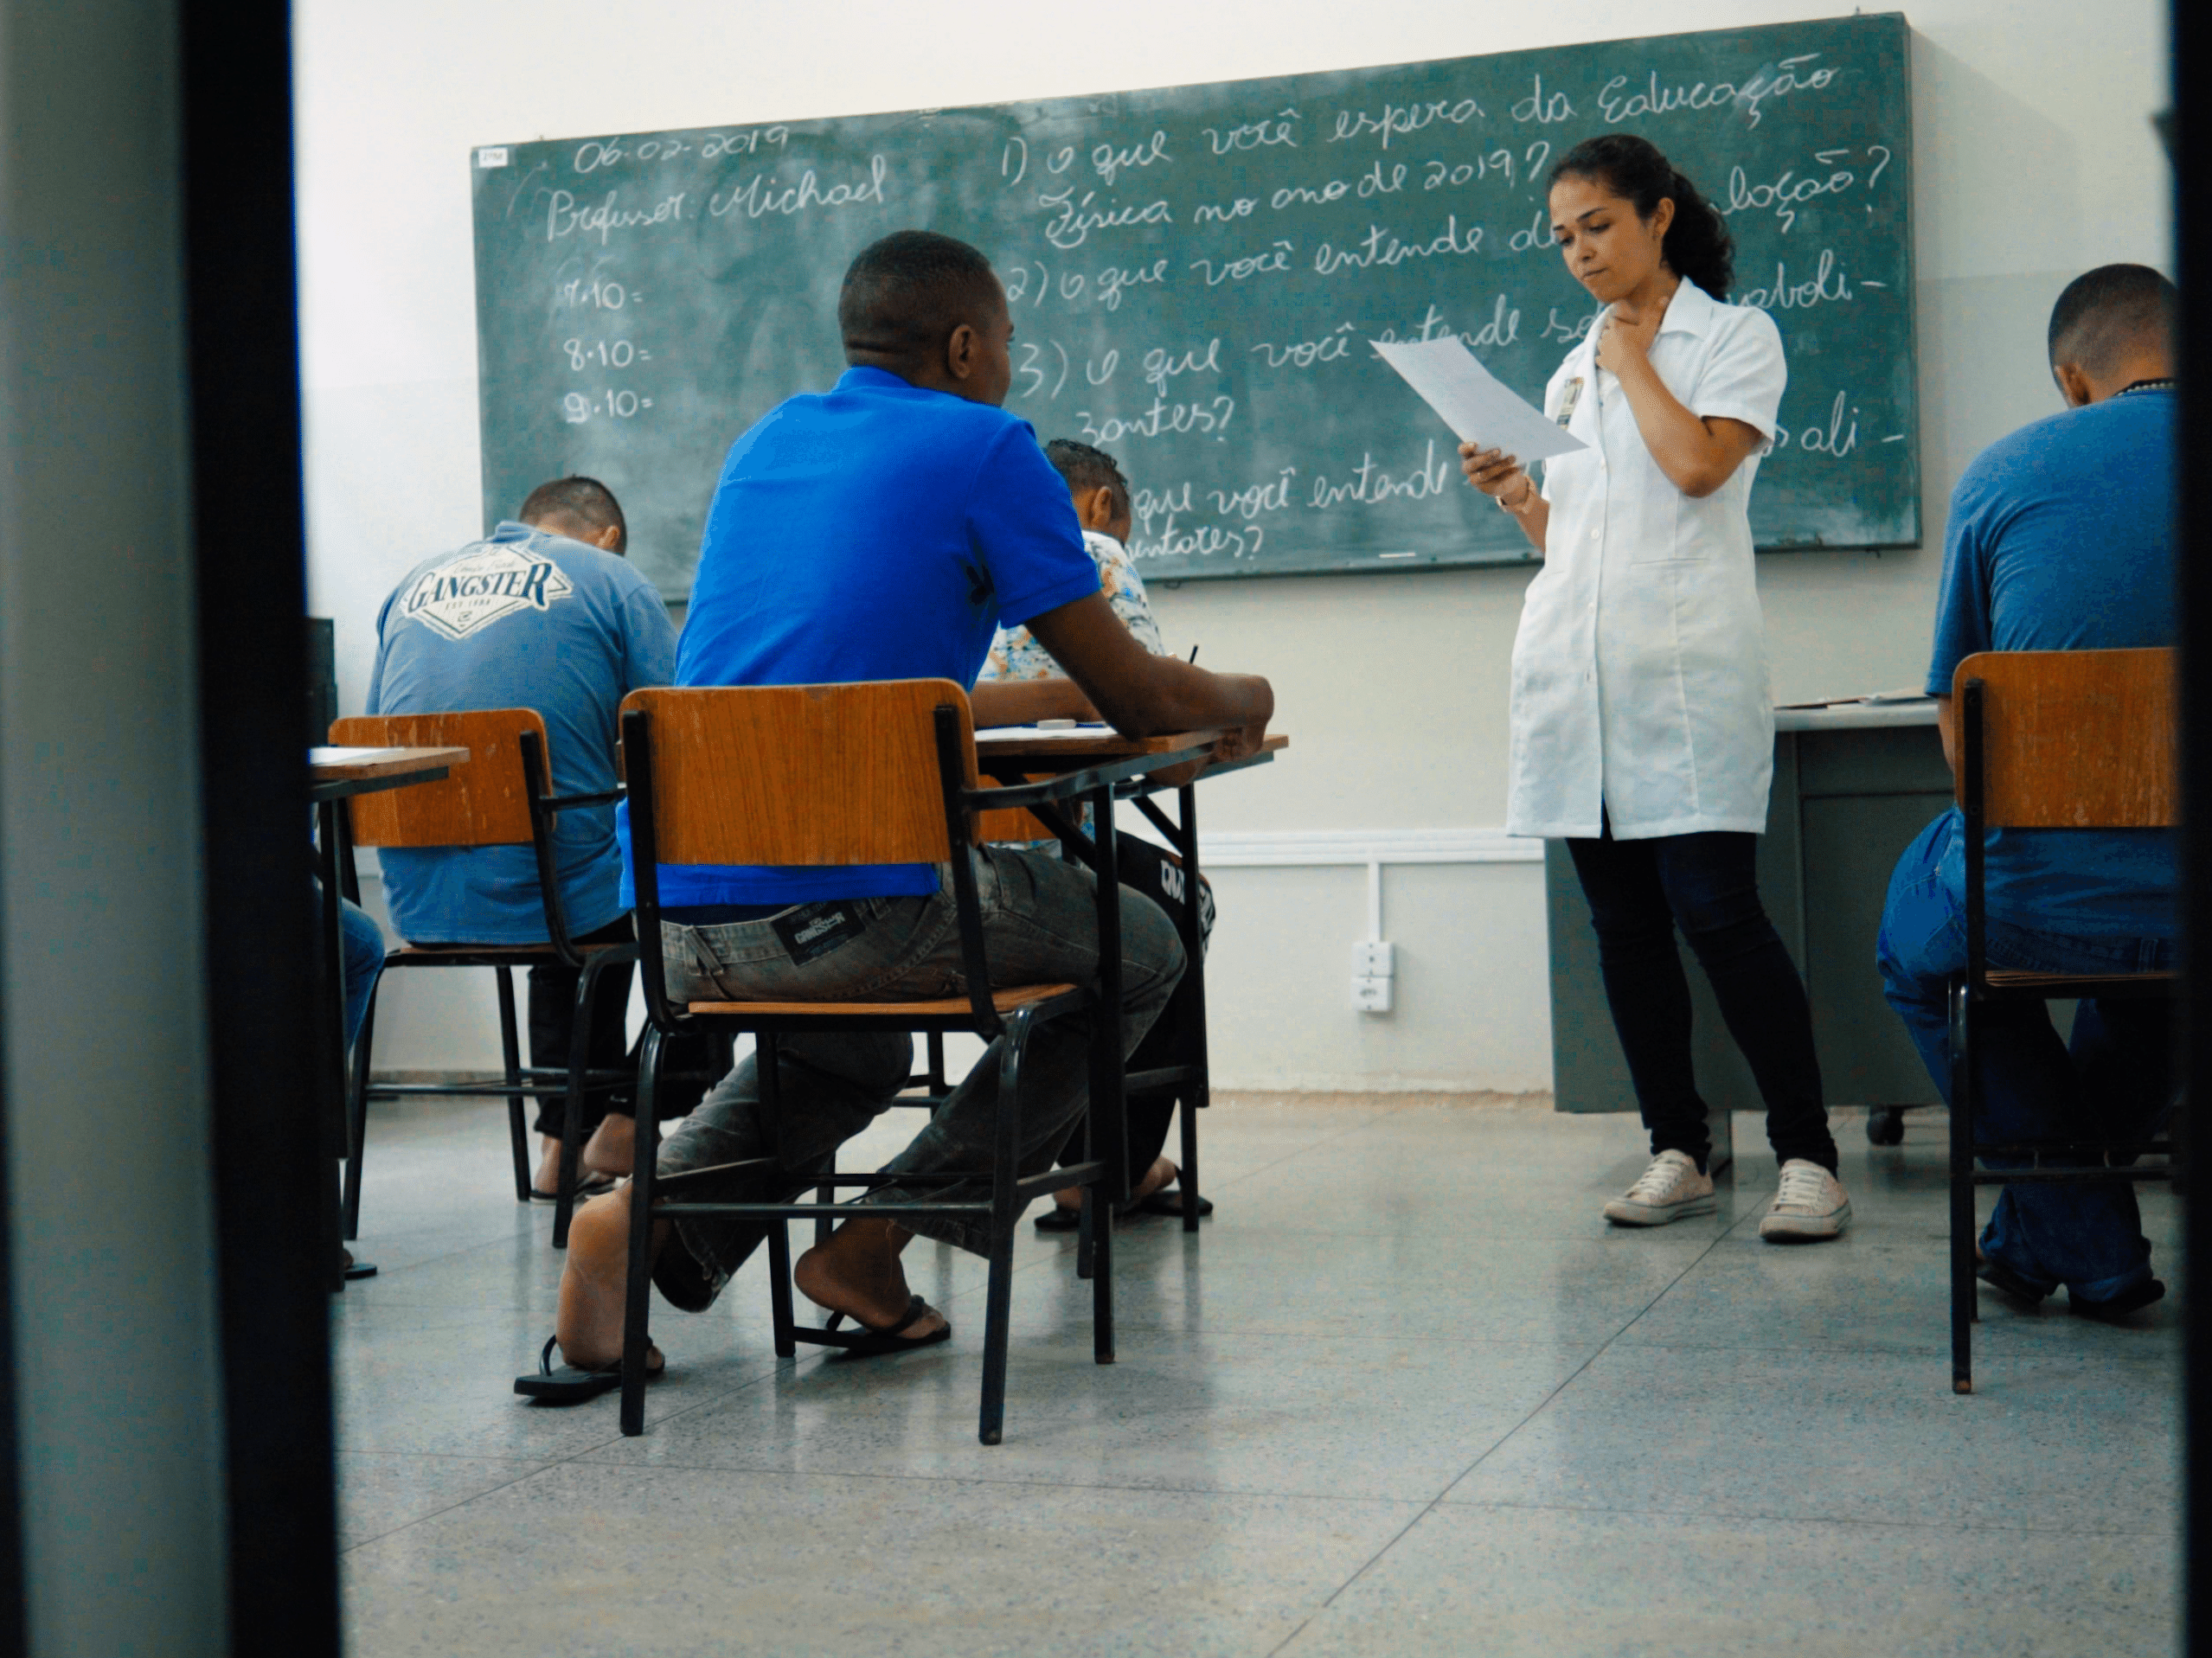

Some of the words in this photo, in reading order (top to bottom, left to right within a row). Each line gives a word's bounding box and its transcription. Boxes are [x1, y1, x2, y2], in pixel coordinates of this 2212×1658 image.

[1002, 136, 1028, 186] 1)
[1092, 131, 1172, 186] que
[1202, 107, 1301, 154] você
[1326, 99, 1484, 150] espera
[1510, 73, 1577, 124] da
[1598, 53, 1842, 130] Educação
[709, 154, 886, 218] Michael
[1193, 197, 1260, 224] no
[1007, 260, 1049, 307] 2)
[1098, 259, 1168, 311] que
[1189, 240, 1293, 286] você
[1314, 214, 1483, 274] entende
[1019, 339, 1069, 400] 3)
[1143, 337, 1221, 398] que
[1250, 321, 1356, 368] você
[1075, 395, 1235, 447] zantes?
[1133, 482, 1192, 536] que
[1207, 467, 1296, 519] você
[407, 562, 554, 613] GANGSTER
